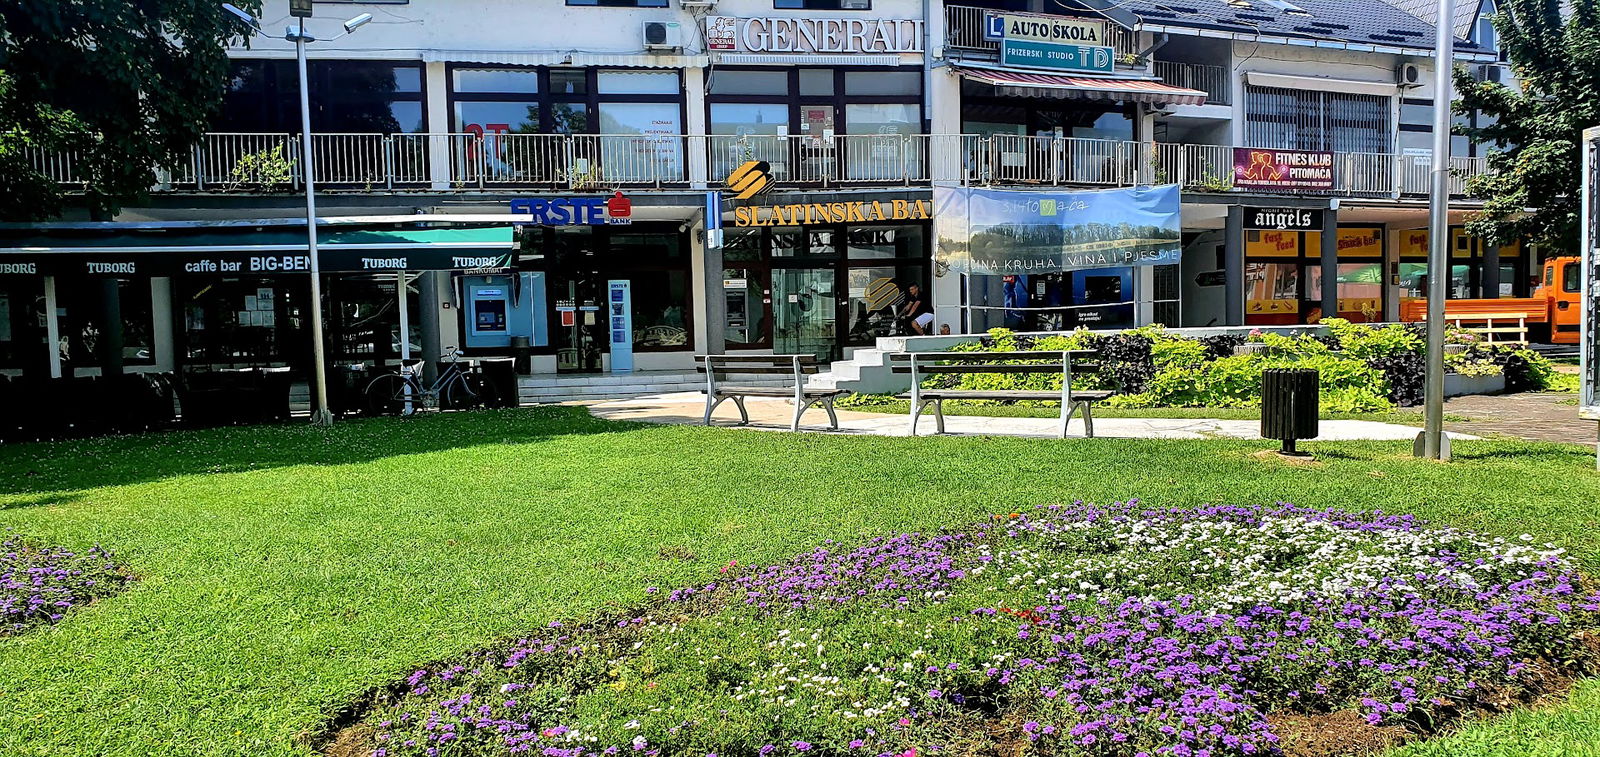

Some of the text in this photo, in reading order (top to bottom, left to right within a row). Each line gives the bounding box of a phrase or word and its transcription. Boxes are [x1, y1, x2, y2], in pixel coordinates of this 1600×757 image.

[743, 17, 924, 53] GENERALI
[1011, 20, 1097, 42] AUTO ŠKOLA
[1007, 47, 1043, 57] FRIZERSKI
[1048, 51, 1074, 60] STUDIO
[1276, 153, 1332, 167] FITNES KLUB
[1290, 167, 1332, 179] PITOMAČA
[511, 198, 605, 225] ERSTE
[735, 199, 933, 227] SLATINSKA BA
[1255, 208, 1312, 230] angels
[1264, 233, 1283, 244] fast
[1276, 238, 1294, 251] food
[362, 257, 407, 269] TUBORG
[452, 256, 497, 268] TUBORG
[1067, 253, 1107, 266] VINA
[1113, 251, 1118, 263] I
[1124, 249, 1178, 263] PJESME
[87, 261, 136, 273] TUBORG
[185, 260, 217, 272] caffe
[220, 259, 242, 272] bar
